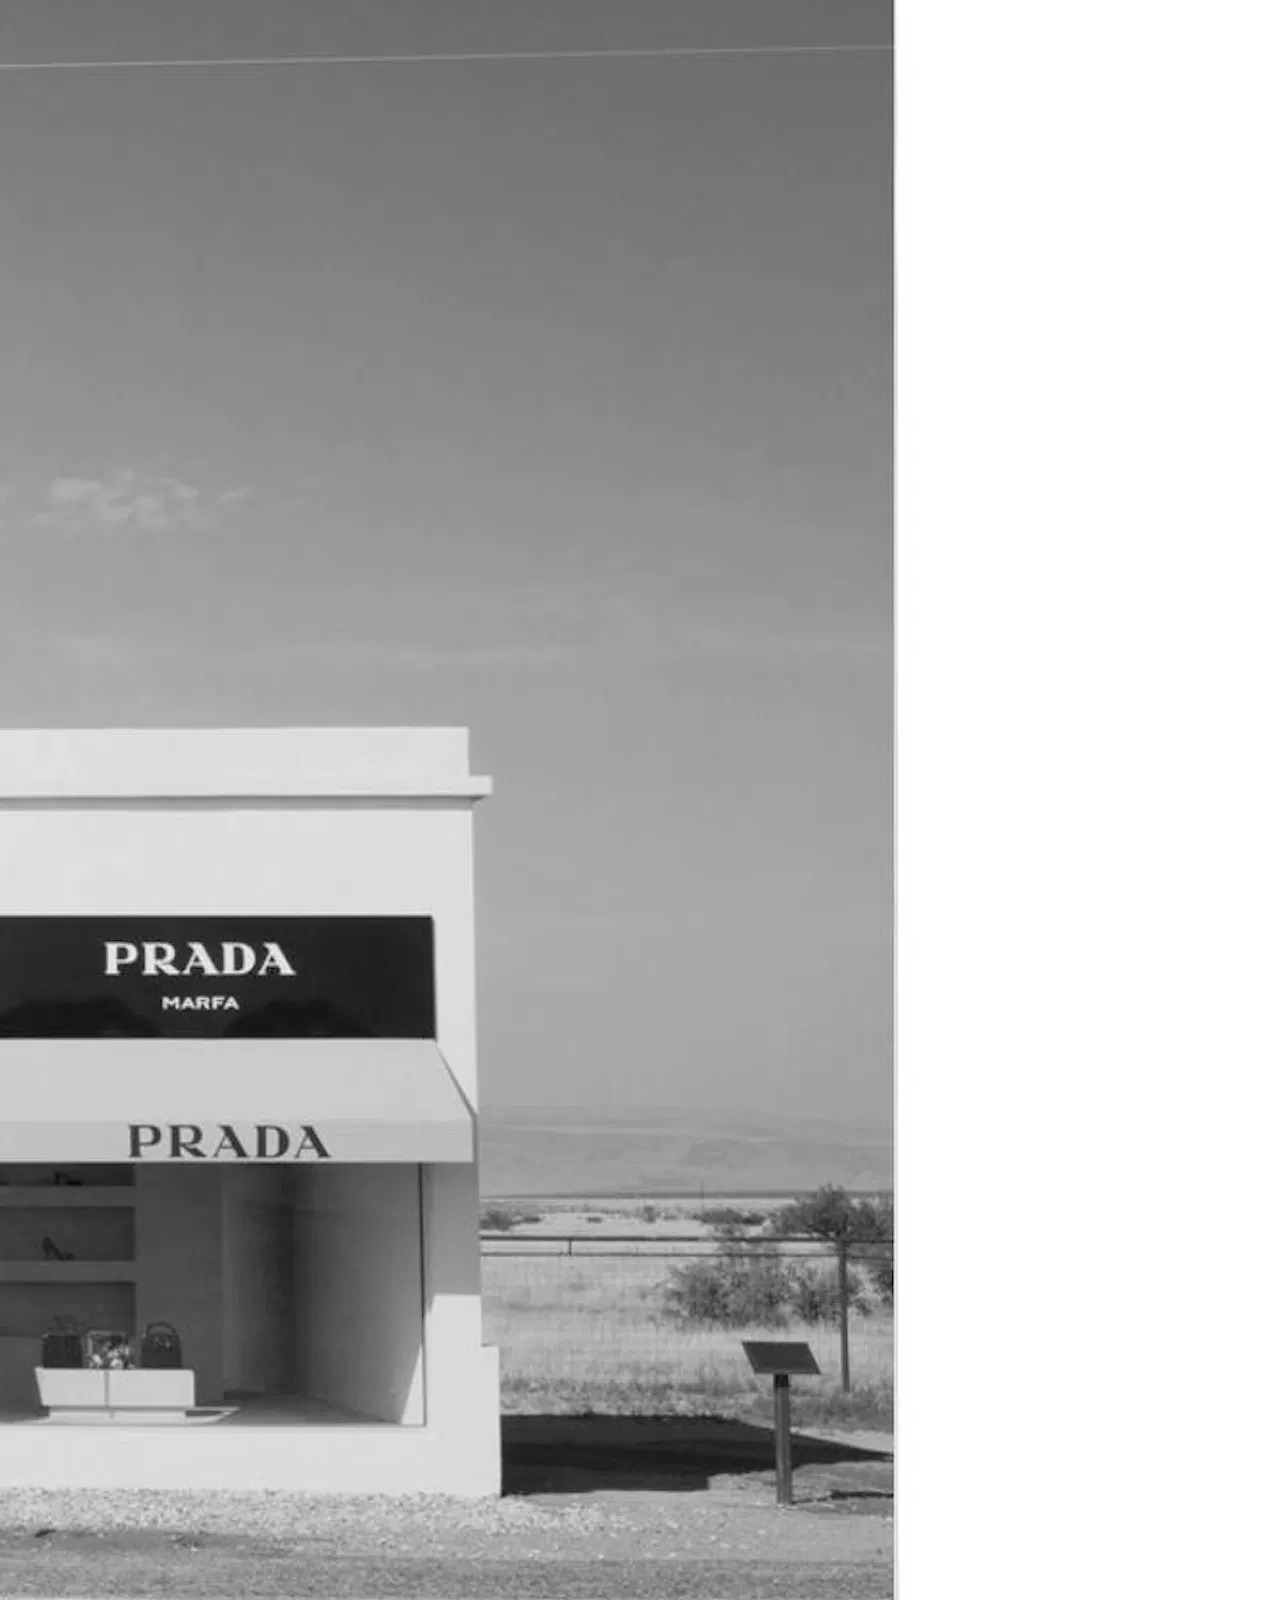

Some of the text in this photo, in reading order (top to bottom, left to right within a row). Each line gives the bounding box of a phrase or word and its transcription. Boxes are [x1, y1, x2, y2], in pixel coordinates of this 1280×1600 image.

[104, 941, 296, 976] PRADA
[161, 995, 239, 1010] MARFA
[129, 1124, 332, 1159] PRADA
